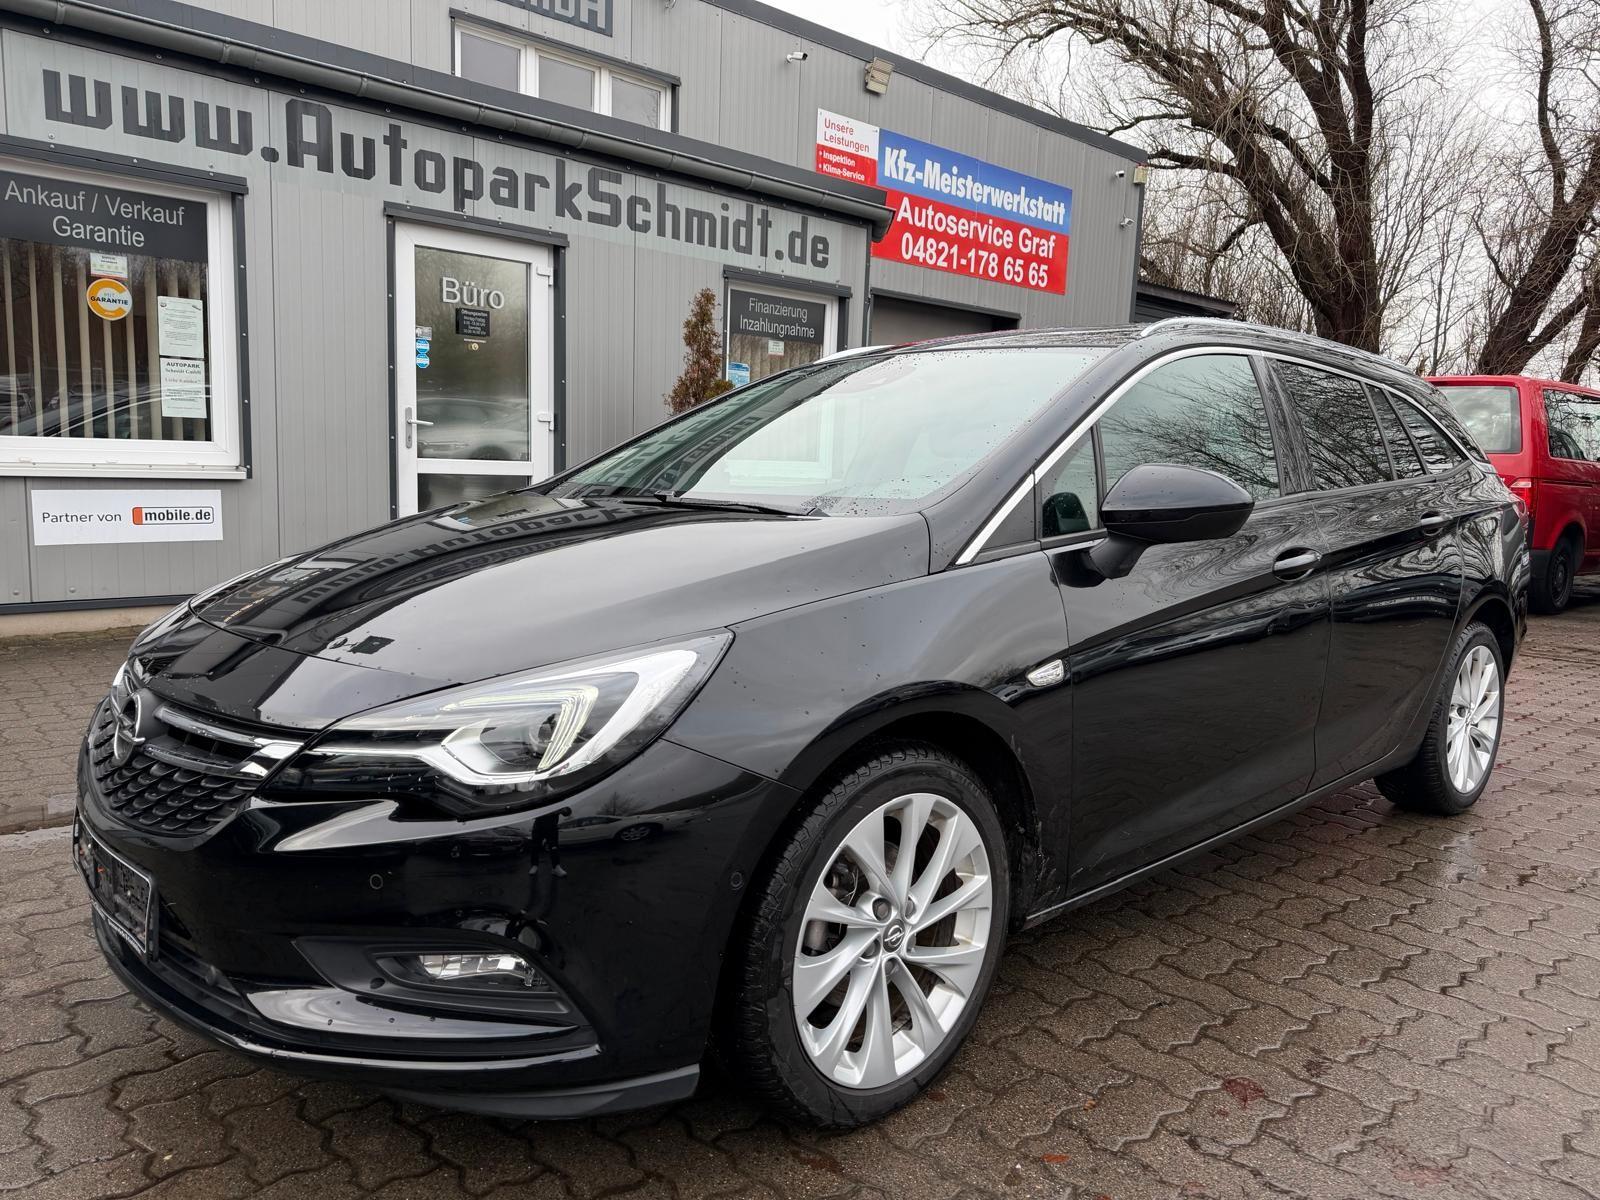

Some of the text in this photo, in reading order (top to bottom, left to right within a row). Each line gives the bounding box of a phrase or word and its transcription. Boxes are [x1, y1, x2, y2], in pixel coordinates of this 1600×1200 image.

[824, 117, 854, 136] Unsere
[824, 132, 869, 153] Leistungen
[42, 69, 830, 268] www.AutoparkSchmidt.de
[823, 151, 855, 167] Inspektion
[823, 163, 865, 182] Klima-Service
[884, 146, 1065, 225] Kfz-Meisterwerkstatt
[5, 180, 185, 226] Ankauf / Verkauf
[52, 215, 145, 247] Garantie
[897, 196, 1056, 259] Autoservice Graf
[901, 232, 1049, 287] 04821-178 65 65
[90, 295, 129, 306] GARANTIE
[442, 276, 505, 309] Büro
[749, 297, 808, 323] Finanzierung
[740, 314, 815, 338] Inzahlungnahme
[166, 361, 201, 369] AUTOPARK
[42, 509, 211, 523] Partner von mobile.de
